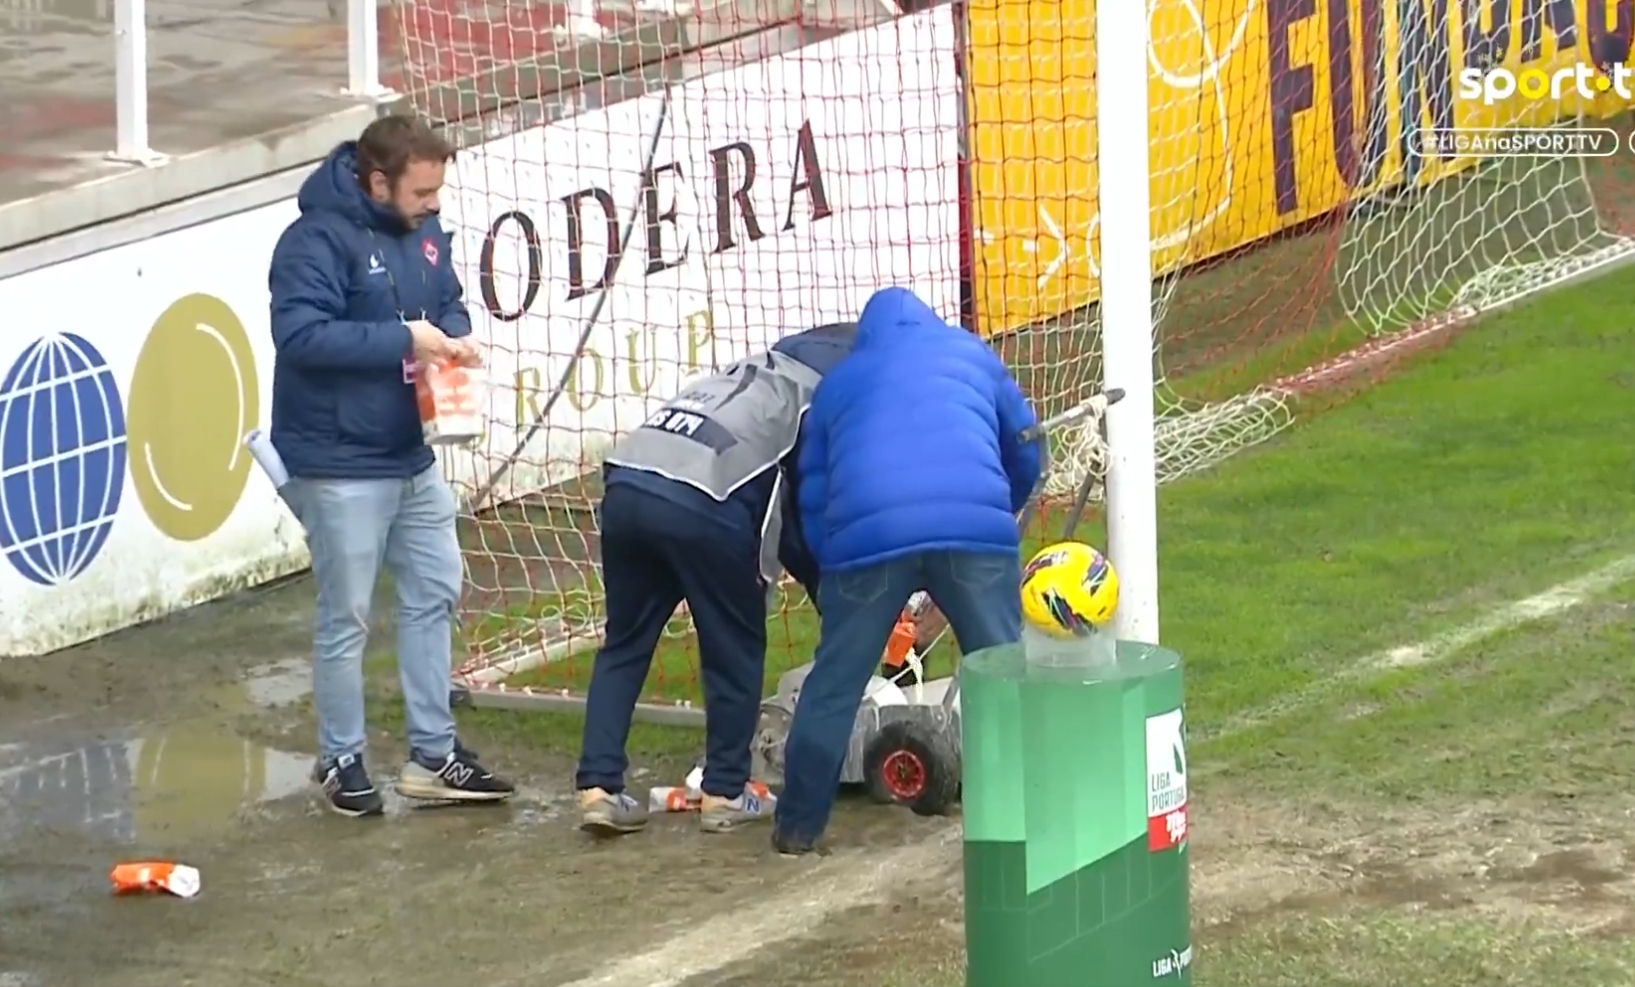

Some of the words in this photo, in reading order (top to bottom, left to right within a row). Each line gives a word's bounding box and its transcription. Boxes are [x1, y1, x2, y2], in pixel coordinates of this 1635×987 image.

[479, 310, 713, 446] ROUP
[1151, 771, 1171, 792] LIGA
[1152, 956, 1173, 978] LIGA
